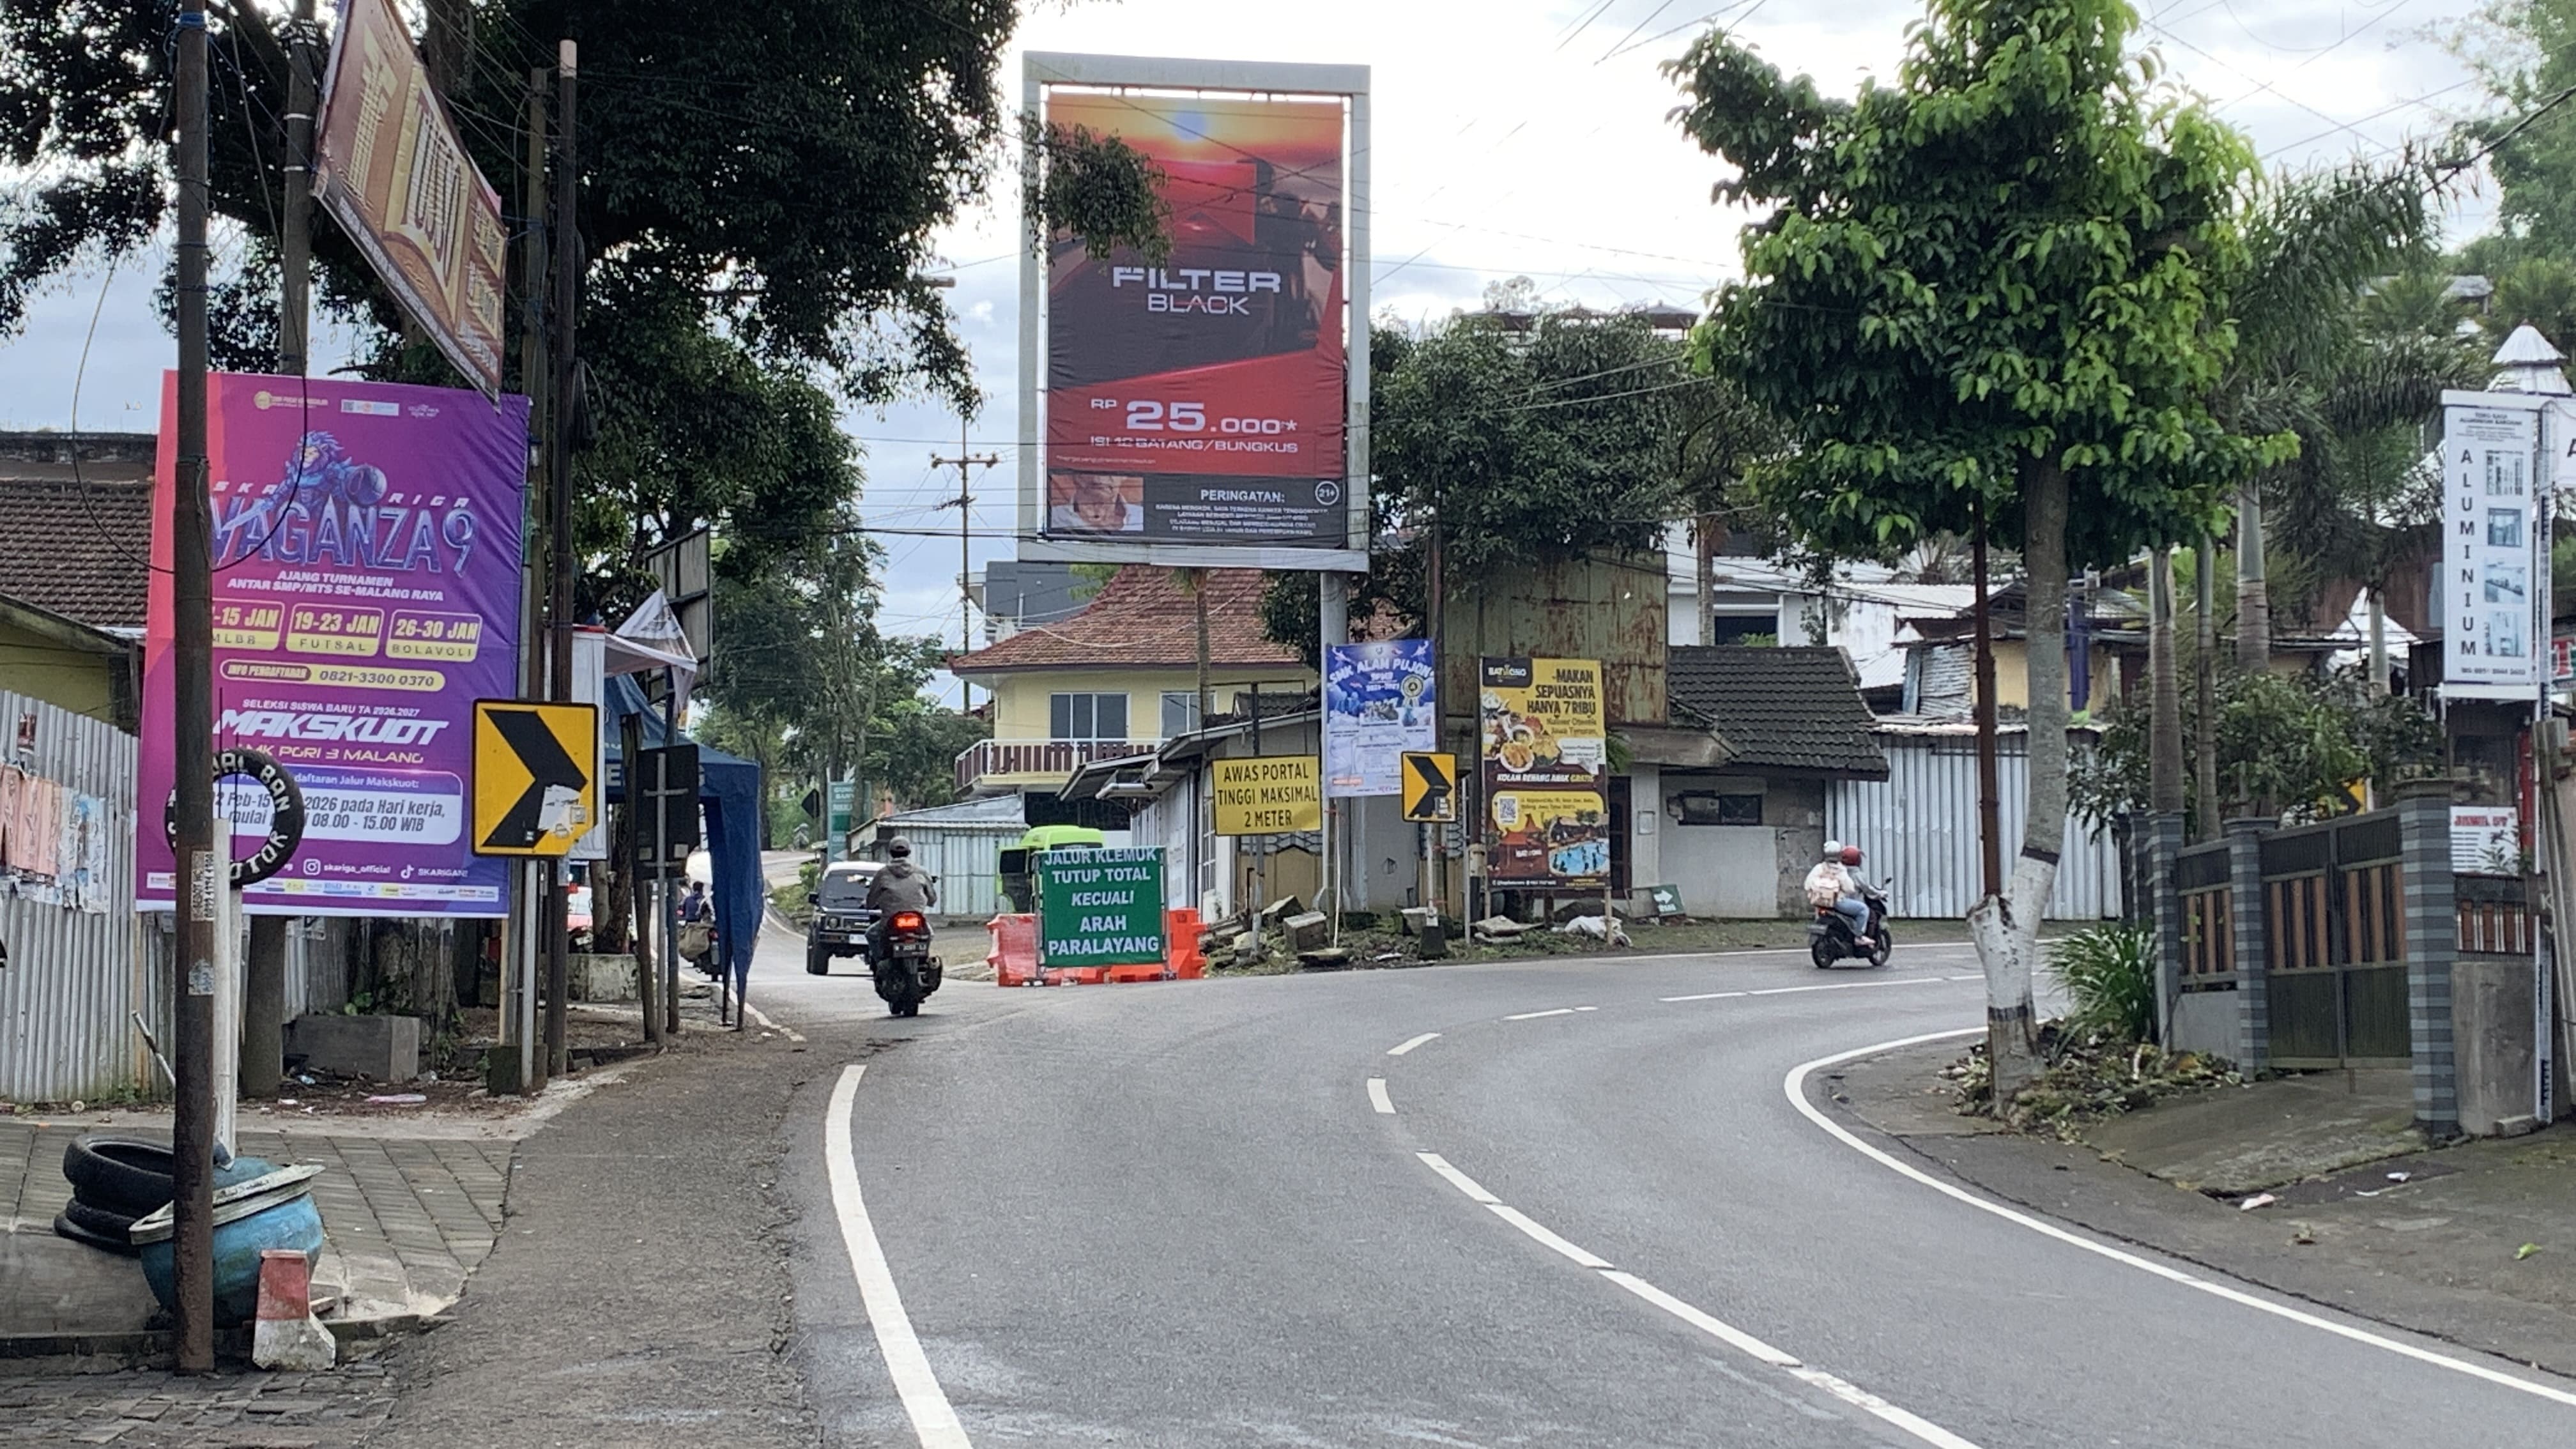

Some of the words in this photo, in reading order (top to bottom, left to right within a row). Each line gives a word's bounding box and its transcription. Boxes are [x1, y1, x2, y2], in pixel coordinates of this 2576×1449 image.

[1113, 266, 1280, 293] FILTER
[1148, 294, 1250, 315] BLACK
[1091, 399, 1117, 410] RP
[1318, 488, 1335, 498] 21+
[2460, 449, 2477, 656] ALUMINIUM
[277, 571, 320, 583] AJANG
[323, 573, 394, 587] TURNAMEN
[227, 578, 271, 590] ANTAR
[272, 580, 332, 595] SMP/MTS
[335, 585, 410, 599] SE-MALANG
[412, 590, 444, 601] RAYA
[212, 606, 241, 626] -15
[244, 608, 280, 628] JAN
[294, 611, 342, 631] 19-23
[346, 615, 380, 634] JAN
[394, 618, 443, 638] 26-30
[447, 622, 479, 640] JAN
[299, 640, 366, 652] FUTSAL
[392, 643, 472, 657] BOLAVOLI
[1556, 669, 1593, 684] MAKAN
[1535, 685, 1596, 700] SEPUASNYA
[242, 699, 288, 710] SELEKSI
[289, 702, 324, 712] SISWA
[326, 703, 356, 714] BARU
[358, 705, 371, 714] TA
[1527, 700, 1561, 714] HANYA
[1563, 701, 1571, 714] 7
[1572, 702, 1596, 715] RIBU
[213, 709, 449, 745] MAKSKUOT
[239, 744, 274, 757] MK
[279, 746, 321, 759] PGRI
[342, 749, 424, 763] MALANG
[340, 775, 365, 786] Jalur
[1223, 765, 1259, 783] AWAS
[1262, 762, 1309, 781] PORTAL
[1217, 788, 1256, 806] TINGGI
[1260, 785, 1318, 803] MAKSIMAL
[305, 796, 338, 811] 2026
[340, 799, 377, 813] pada
[377, 799, 406, 815] Hari
[408, 801, 445, 818] kerja,
[312, 813, 350, 829] 08.00
[363, 816, 396, 831] 15.00
[401, 816, 424, 831] WIB
[1244, 812, 1251, 827] 2
[1255, 809, 1292, 827] METER
[230, 831, 289, 880] OTOR
[1045, 849, 1092, 866] JALUR
[1096, 848, 1157, 863] KLEMUK
[1052, 869, 1101, 884] TUTUP
[1105, 867, 1151, 882] TOTAL
[1071, 890, 1134, 907] KECUALI
[1080, 915, 1127, 933] ARAH
[1048, 936, 1160, 956] PARALAYANG
